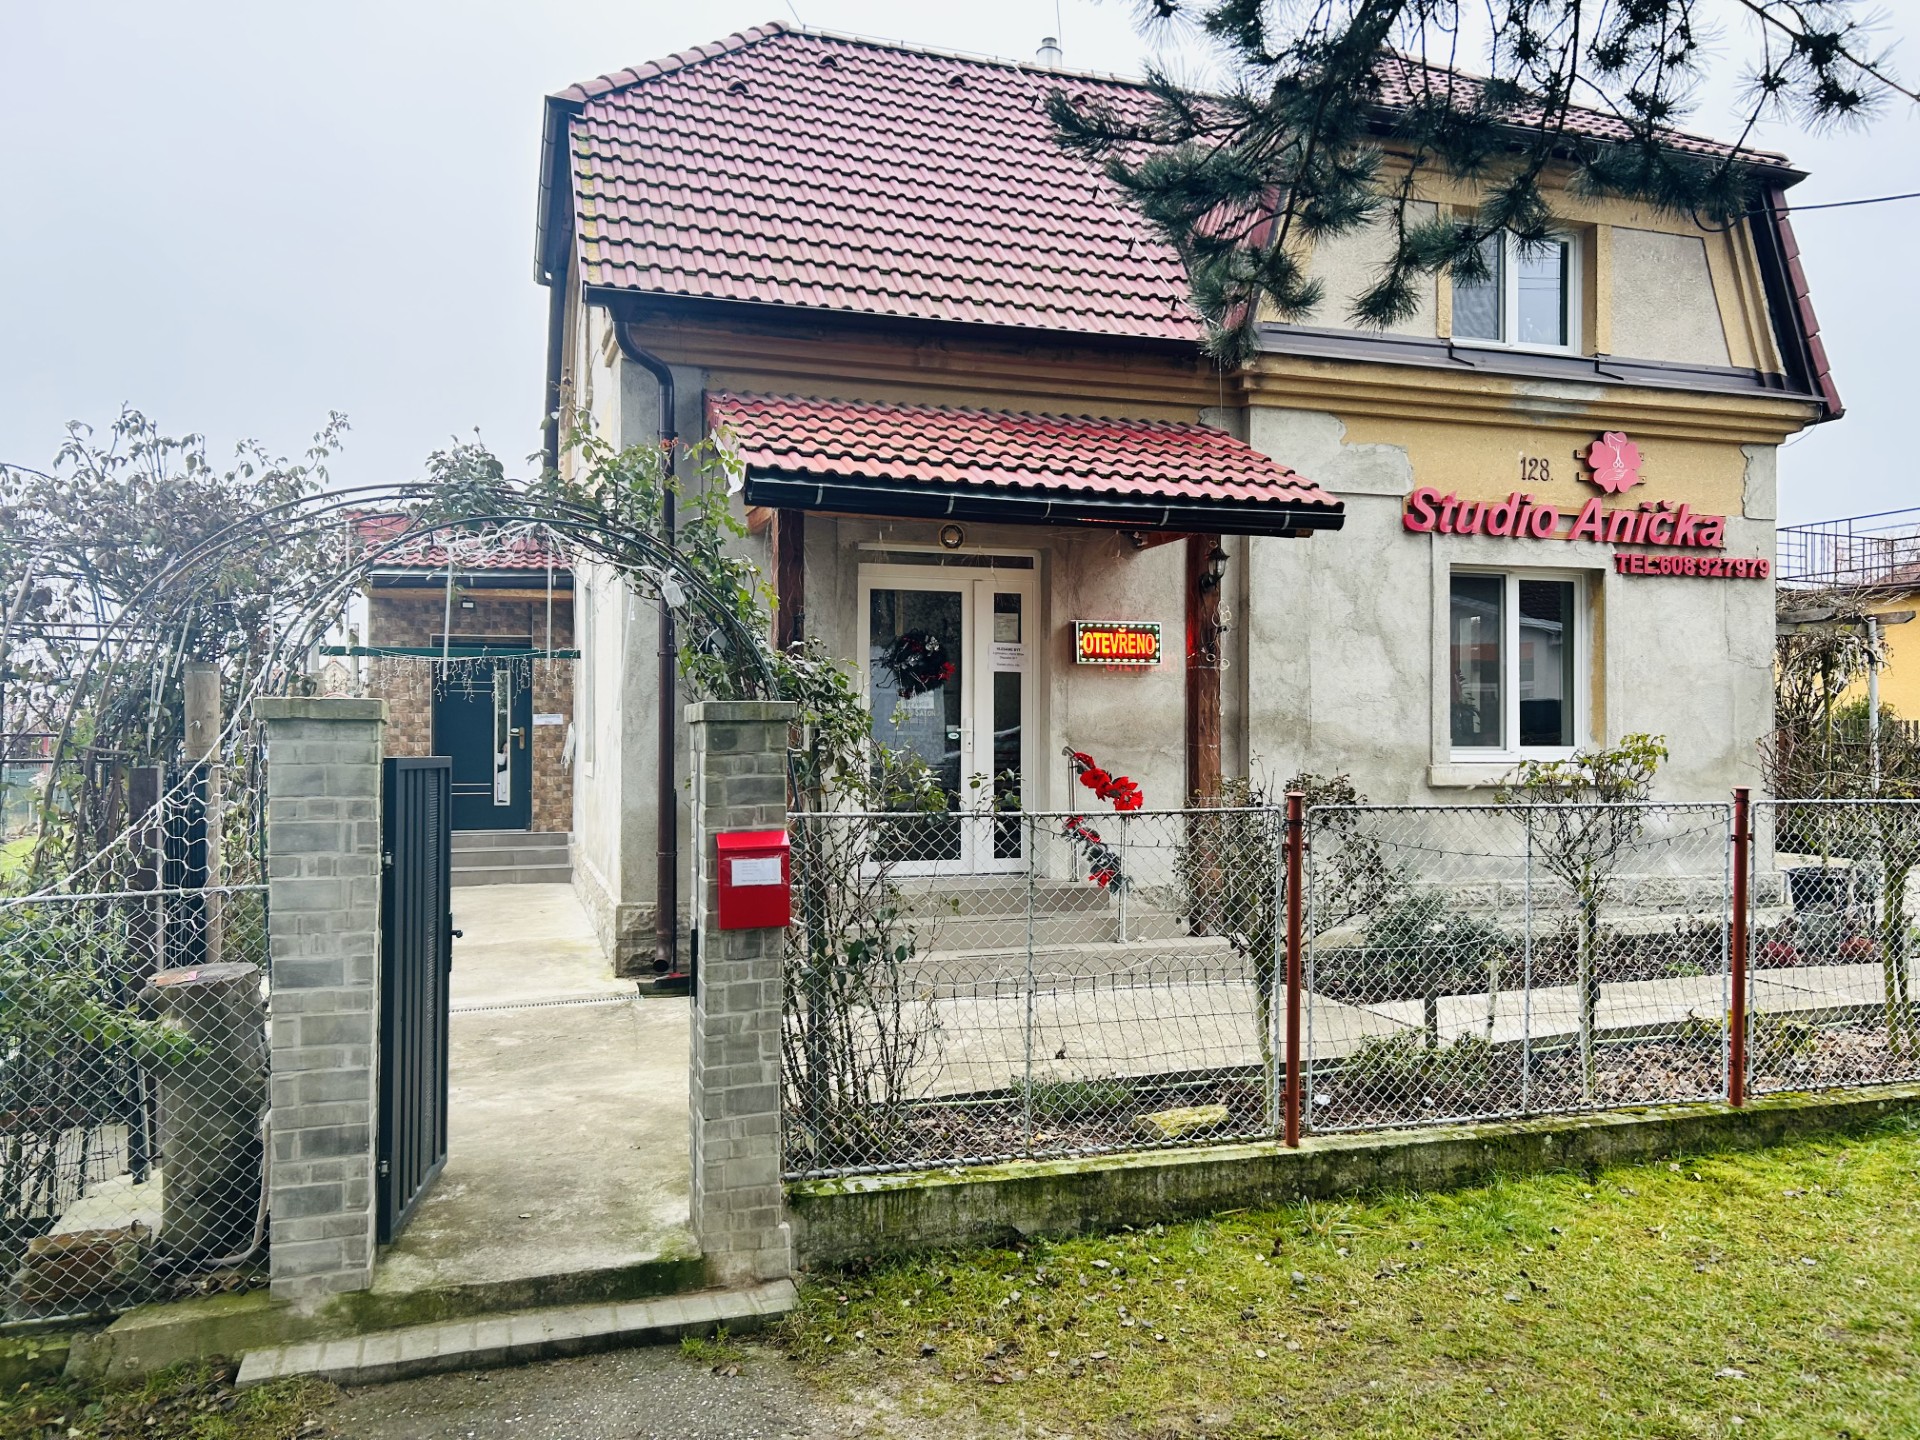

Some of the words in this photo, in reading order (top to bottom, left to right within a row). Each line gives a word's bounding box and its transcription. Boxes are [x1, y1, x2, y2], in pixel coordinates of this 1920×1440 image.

[1403, 486, 1559, 539] Studio
[1568, 497, 1725, 547] Anička
[1082, 627, 1156, 655] OTEVŘENO
